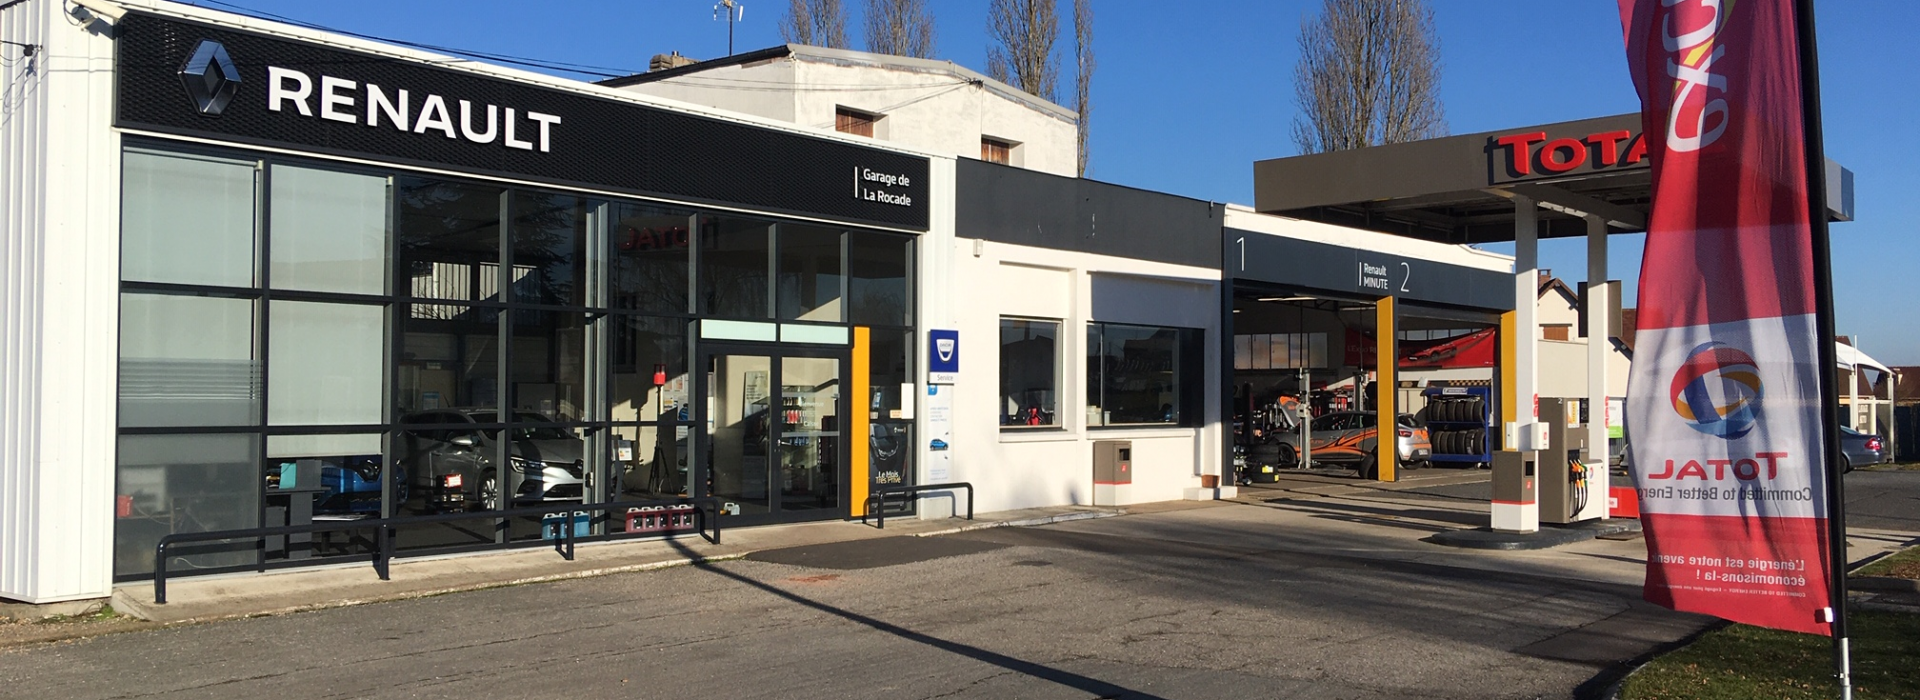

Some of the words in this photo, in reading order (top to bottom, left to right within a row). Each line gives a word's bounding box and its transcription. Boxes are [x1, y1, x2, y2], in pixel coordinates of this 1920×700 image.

[267, 65, 561, 152] RENAULT
[1498, 130, 1648, 175] TOTA
[863, 168, 897, 187] Garage
[898, 174, 910, 187] de
[863, 188, 876, 201] La
[877, 190, 911, 206] Rocade
[1236, 236, 1245, 271] 1
[1363, 262, 1387, 276] Renault
[1400, 262, 1410, 292] 2
[1363, 276, 1388, 290] MINUTE
